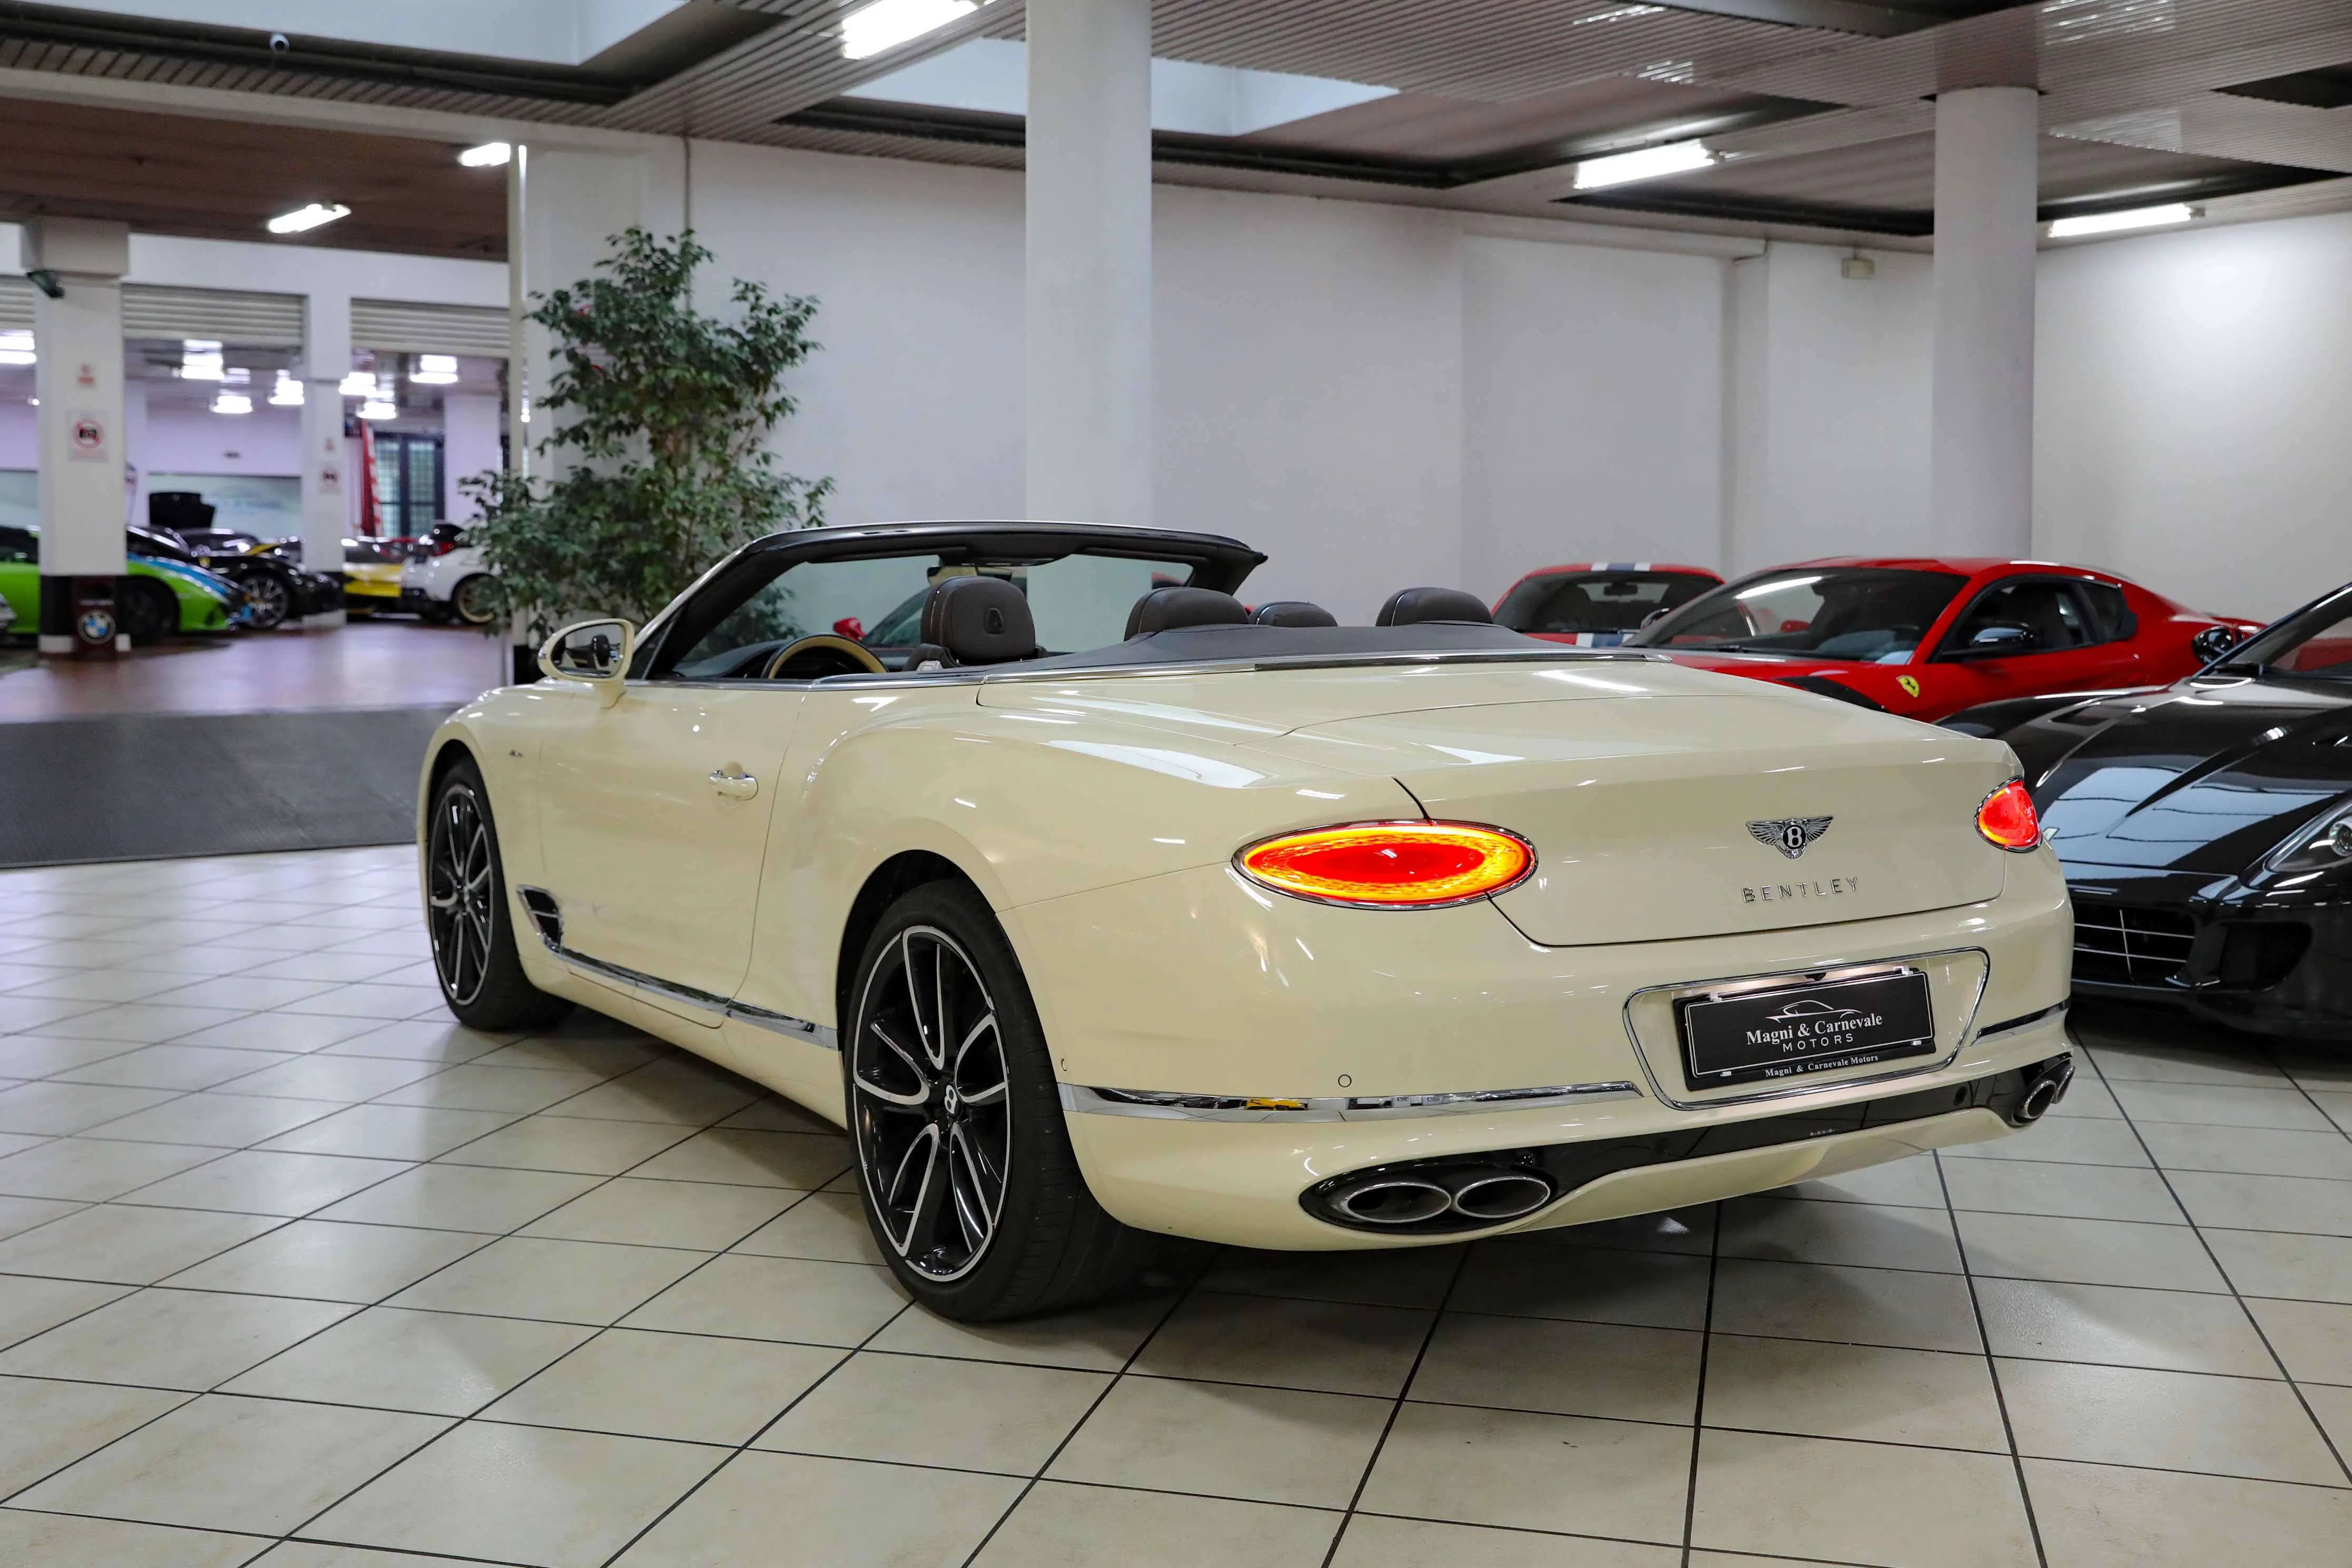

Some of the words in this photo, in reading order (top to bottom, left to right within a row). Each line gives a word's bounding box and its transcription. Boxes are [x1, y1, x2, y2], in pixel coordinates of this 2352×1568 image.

[1787, 826, 1802, 847] B
[1742, 877, 1858, 903] BENTLEY
[1746, 1025, 1794, 1045] Magni
[1797, 1023, 1811, 1037] &
[1815, 1013, 1883, 1035] Carnevale
[1782, 1033, 1854, 1052] MOTORS
[1765, 1066, 1792, 1077] Magni
[1808, 1059, 1849, 1071] Carnevale
[1850, 1054, 1879, 1065] Motors
[944, 1084, 958, 1114] B
